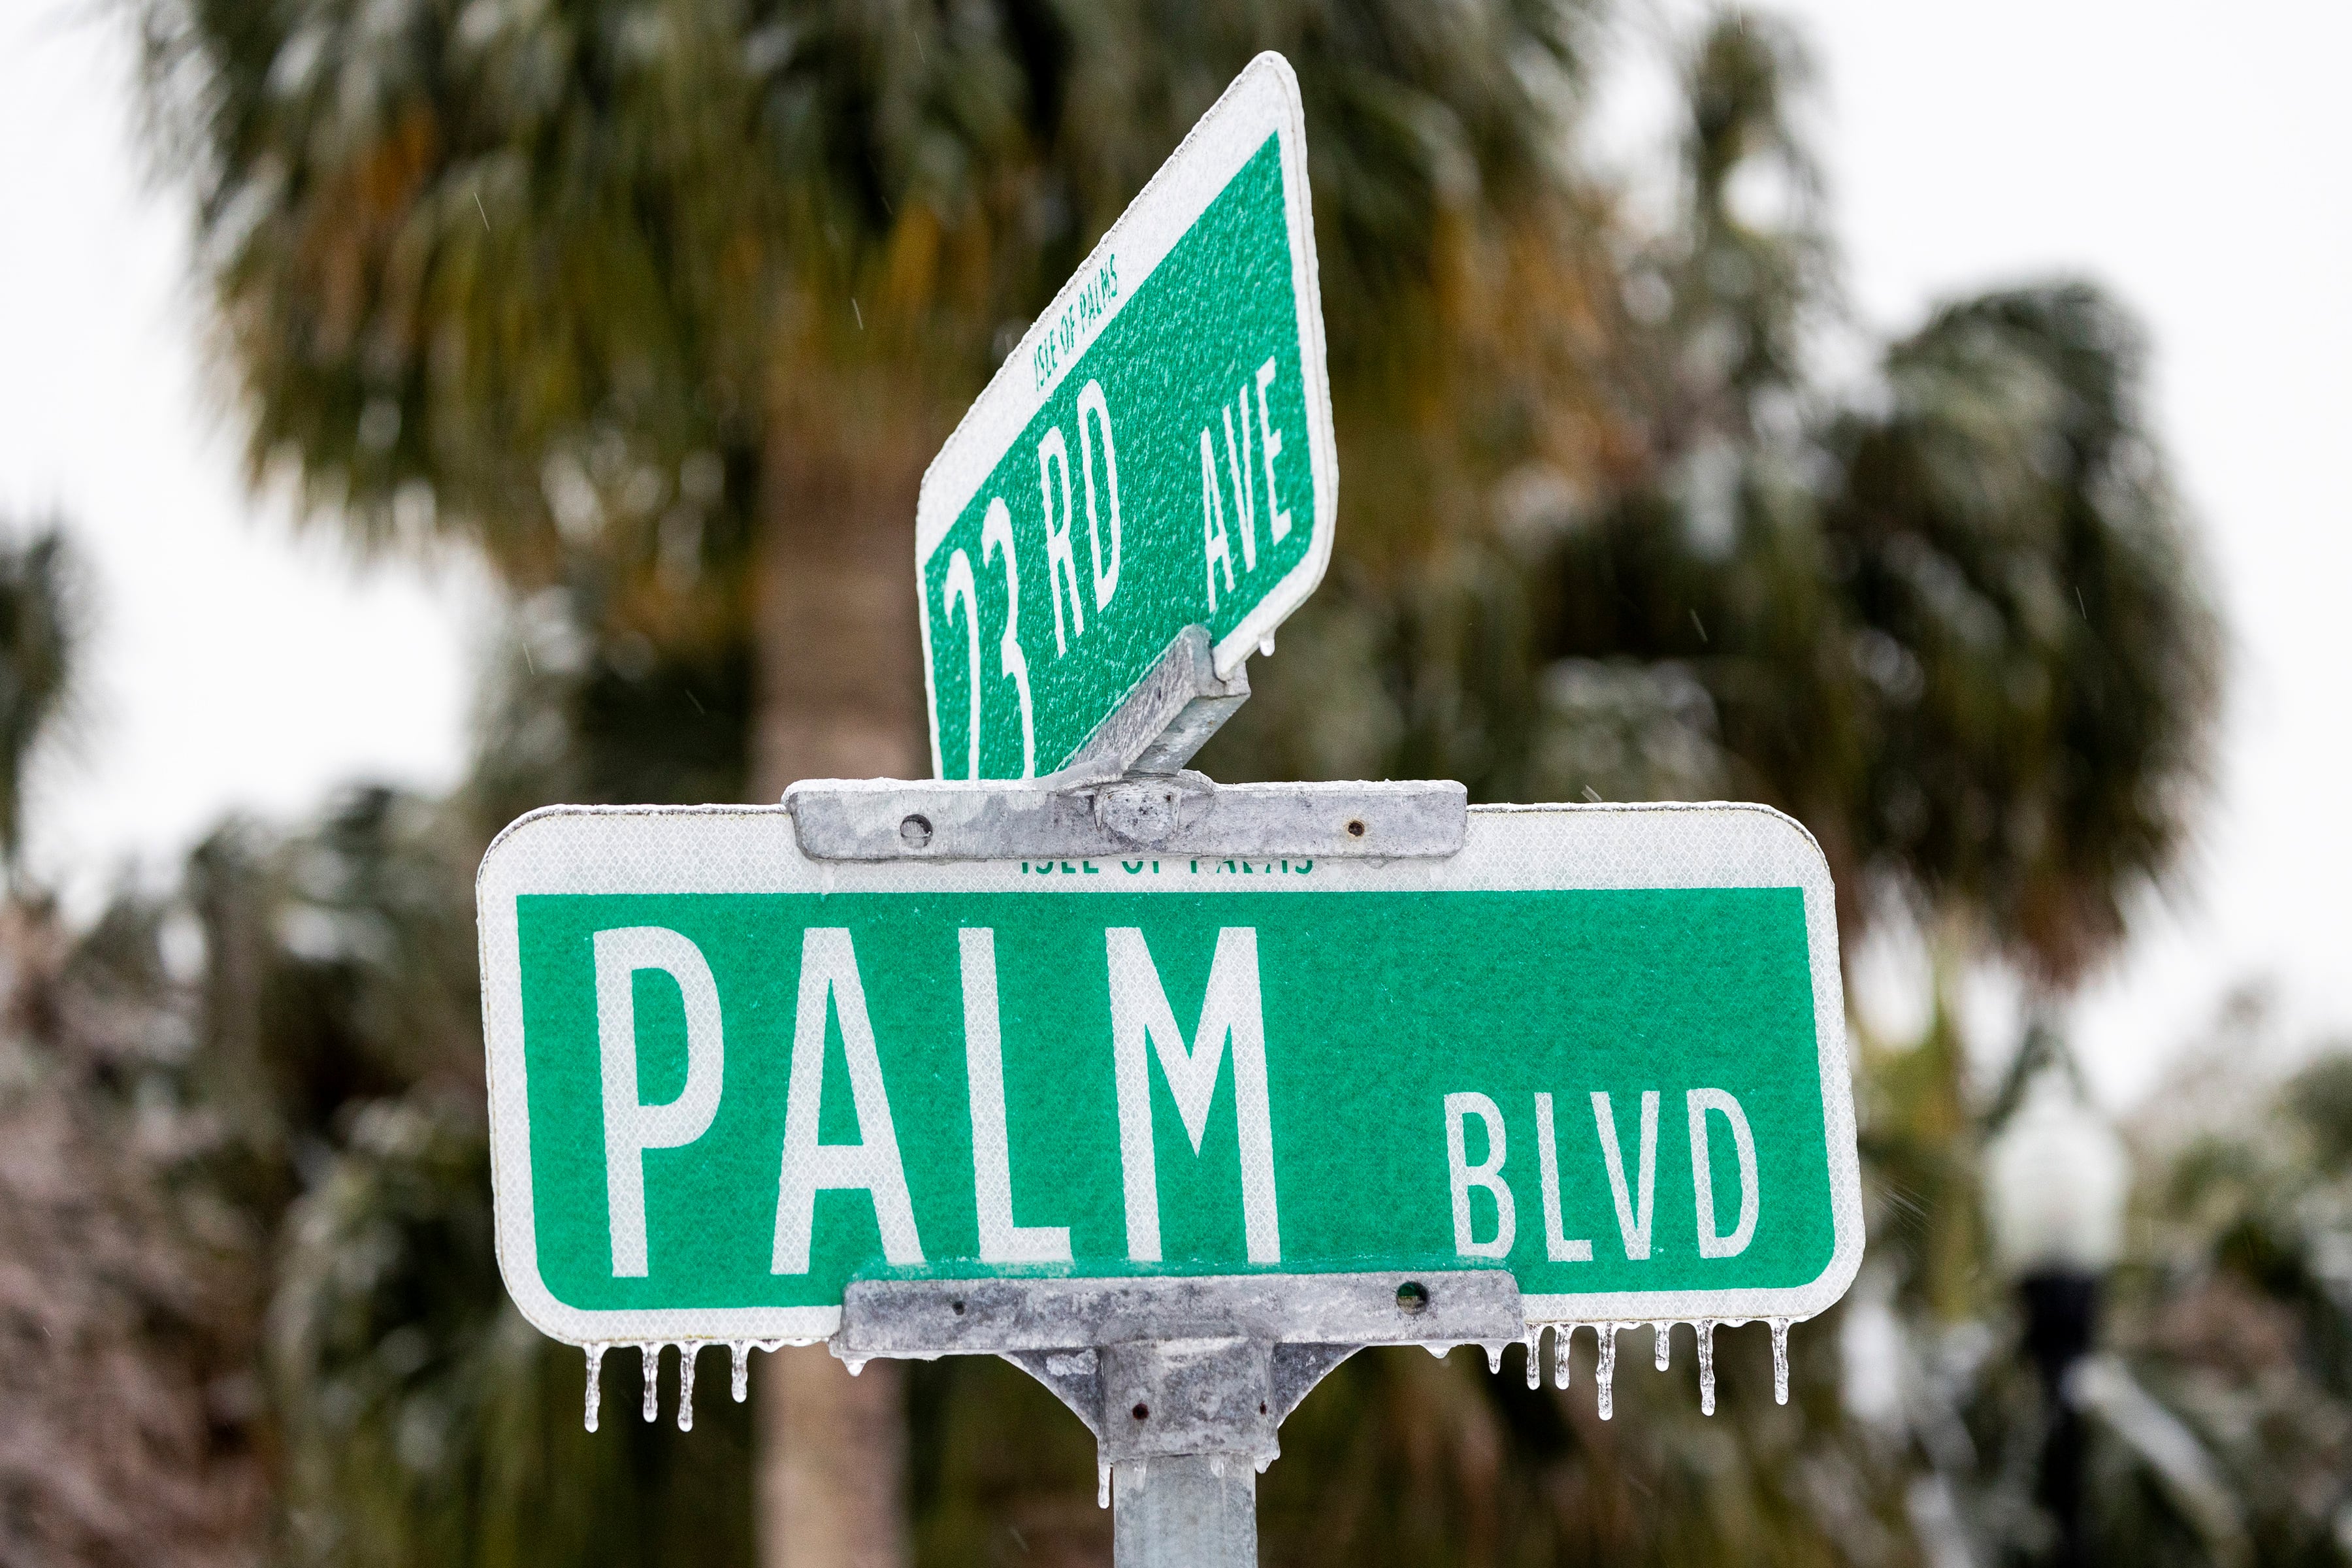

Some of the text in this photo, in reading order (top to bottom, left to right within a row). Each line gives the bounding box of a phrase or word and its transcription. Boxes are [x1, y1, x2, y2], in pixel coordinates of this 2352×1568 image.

[1034, 253, 1117, 392] ISLE OF PALMS
[1201, 355, 1292, 613] AVE
[593, 926, 1759, 1277] PALM BLVD
